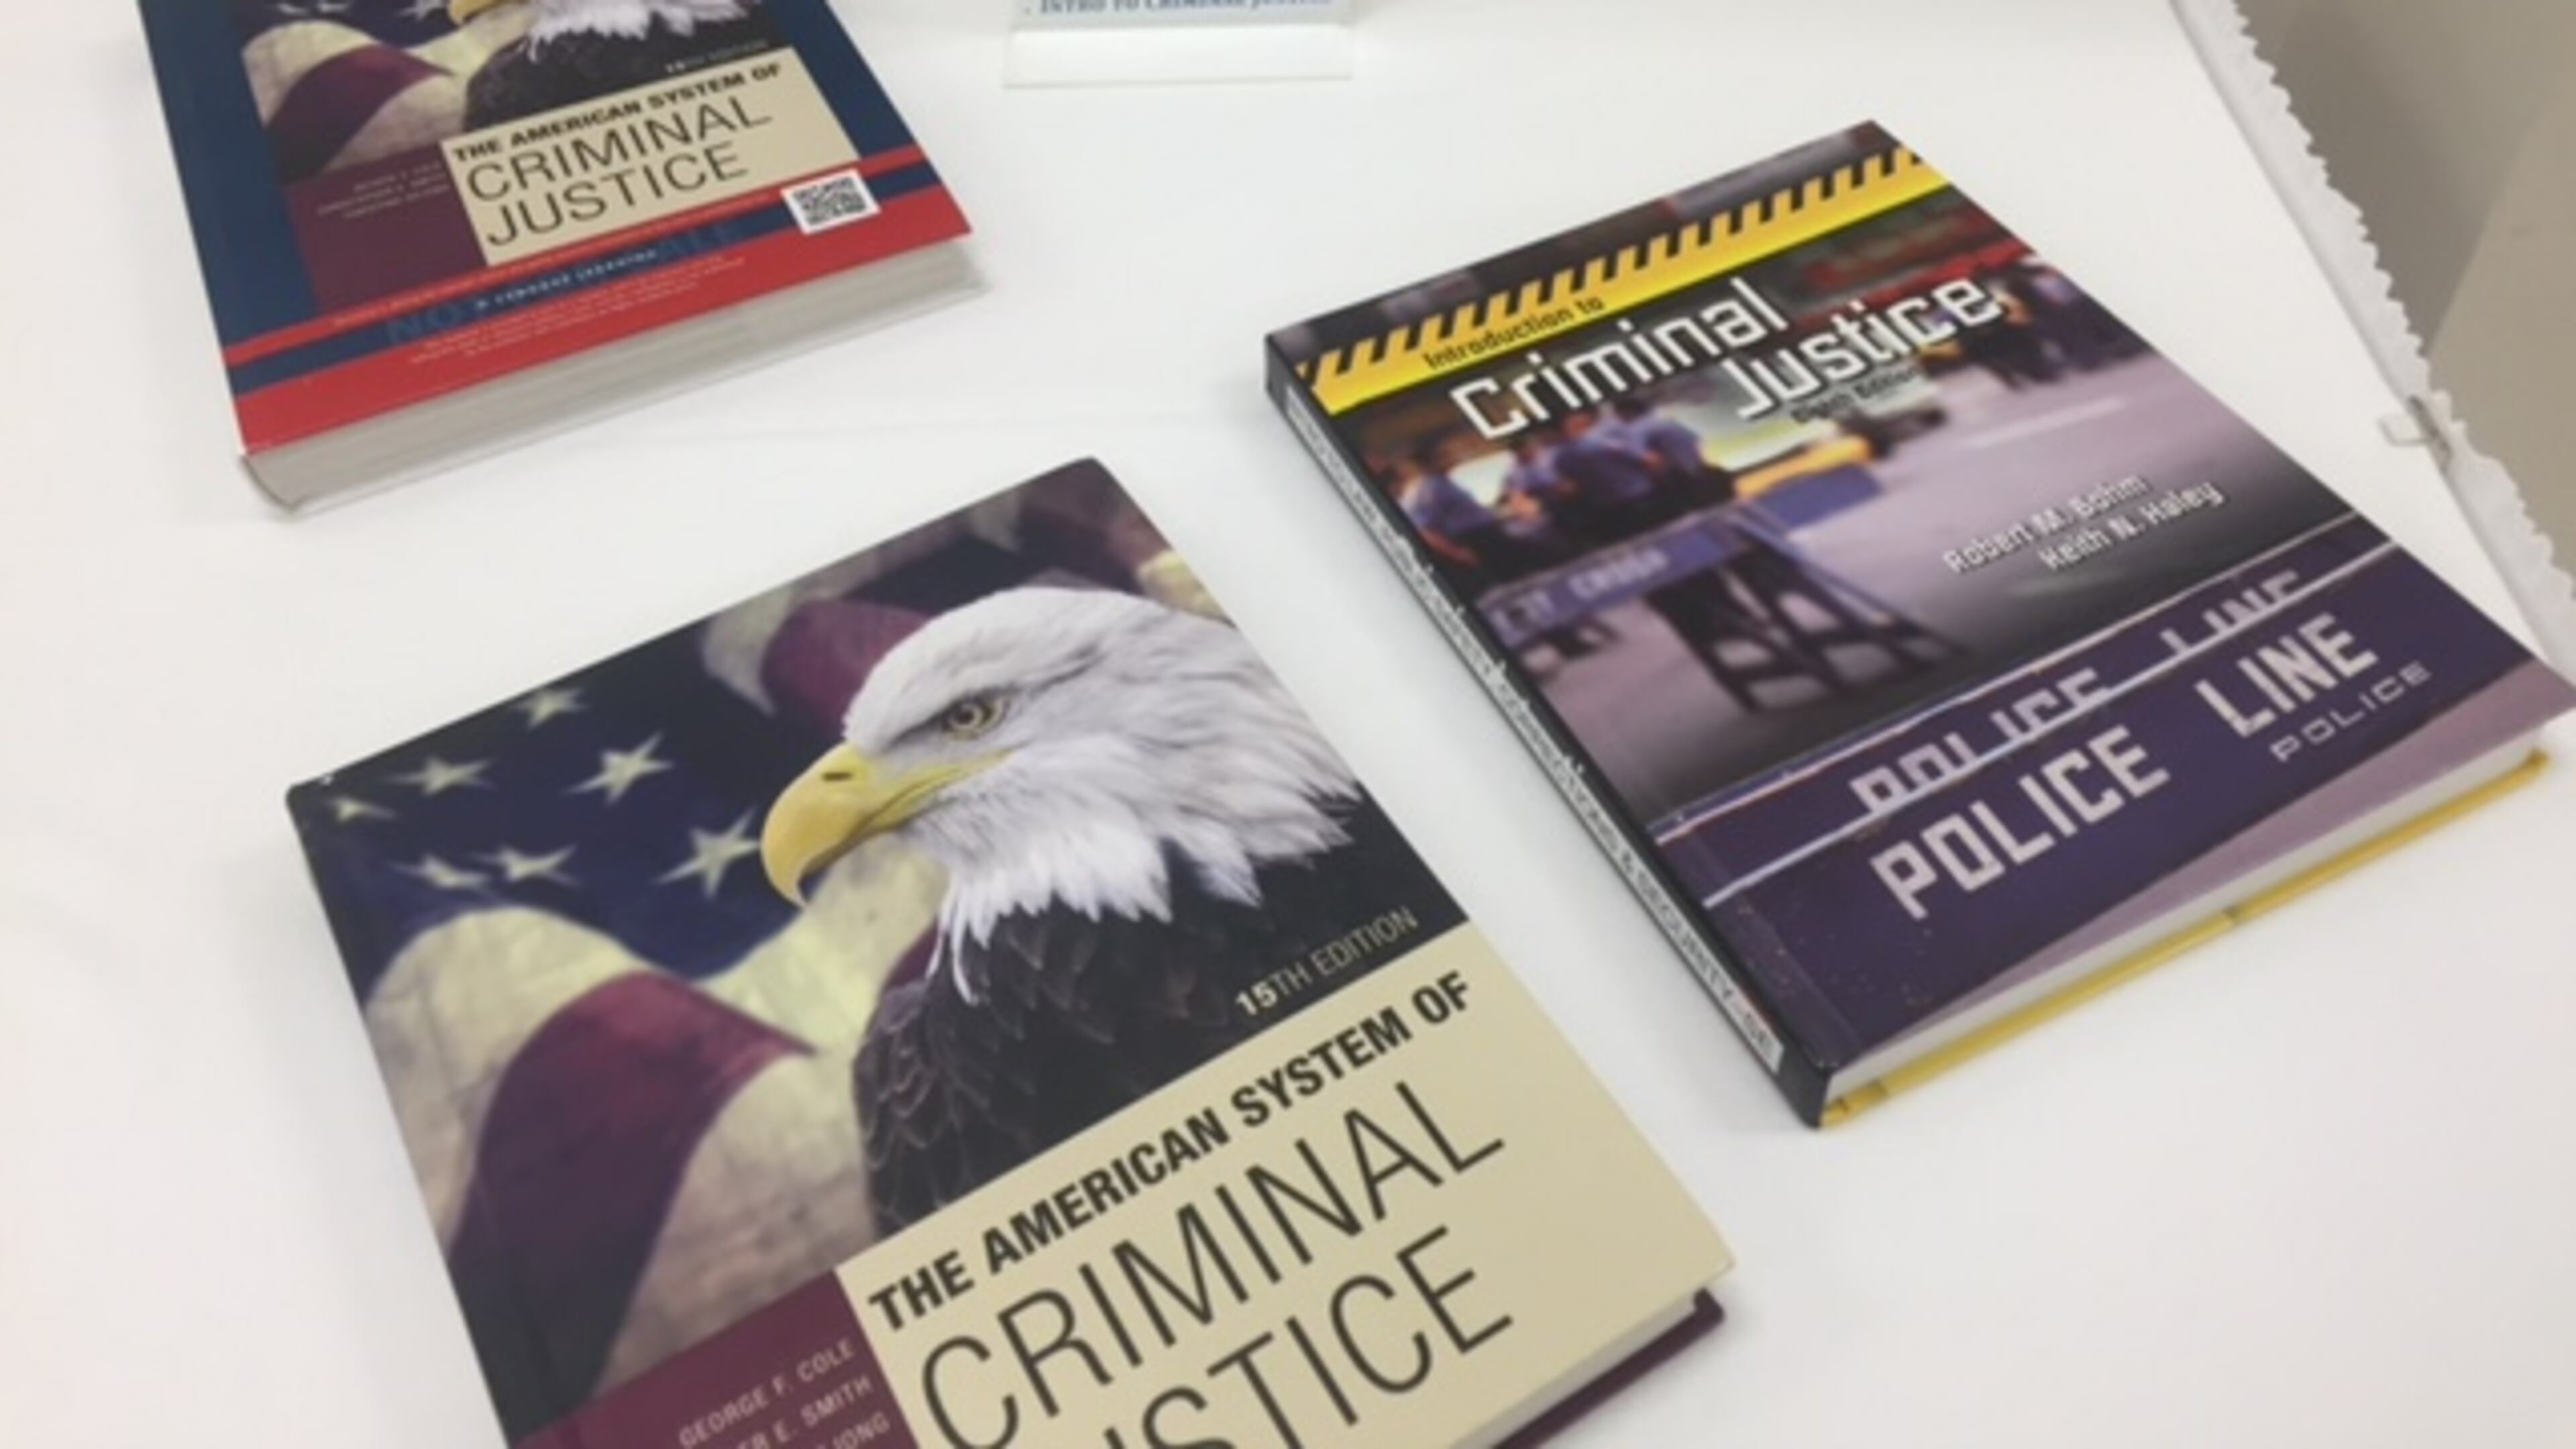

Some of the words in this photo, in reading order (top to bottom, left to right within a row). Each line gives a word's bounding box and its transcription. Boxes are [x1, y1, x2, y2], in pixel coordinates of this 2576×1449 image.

[453, 140, 503, 163] THE
[511, 101, 642, 146] AMERICAN
[647, 70, 747, 110] SYSTEM
[751, 62, 782, 83] OF
[466, 96, 773, 201] CRIMINAL
[486, 139, 749, 247] JUSTICE
[1421, 307, 1575, 370] Introduction
[1574, 296, 1605, 315] to
[1449, 276, 1789, 441] Criminal
[1720, 274, 2003, 421] Justice
[1943, 521, 2034, 573] Robert
[2066, 473, 2151, 519] Bohm
[2037, 521, 2113, 571] Keith
[2139, 480, 2229, 524] Haley
[2269, 660, 2432, 763] POLICE
[1869, 724, 2171, 922] POLICE
[2195, 612, 2380, 739] LINE
[1235, 966, 1313, 1016] 15TH
[1308, 904, 1419, 977] EDITION
[867, 1248, 975, 1334] THE
[979, 1106, 1232, 1276] AMERICAN
[1230, 1005, 1415, 1129] SYSTEM
[1411, 970, 1469, 1025] OF
[921, 1081, 1505, 1449] CRIMINAL
[1102, 1225, 1513, 1449] STICE
[678, 1385, 769, 1448] GEORGE
[770, 1374, 794, 1398] F.
[795, 1338, 857, 1383] COLE
[800, 1375, 873, 1428] SMITH
